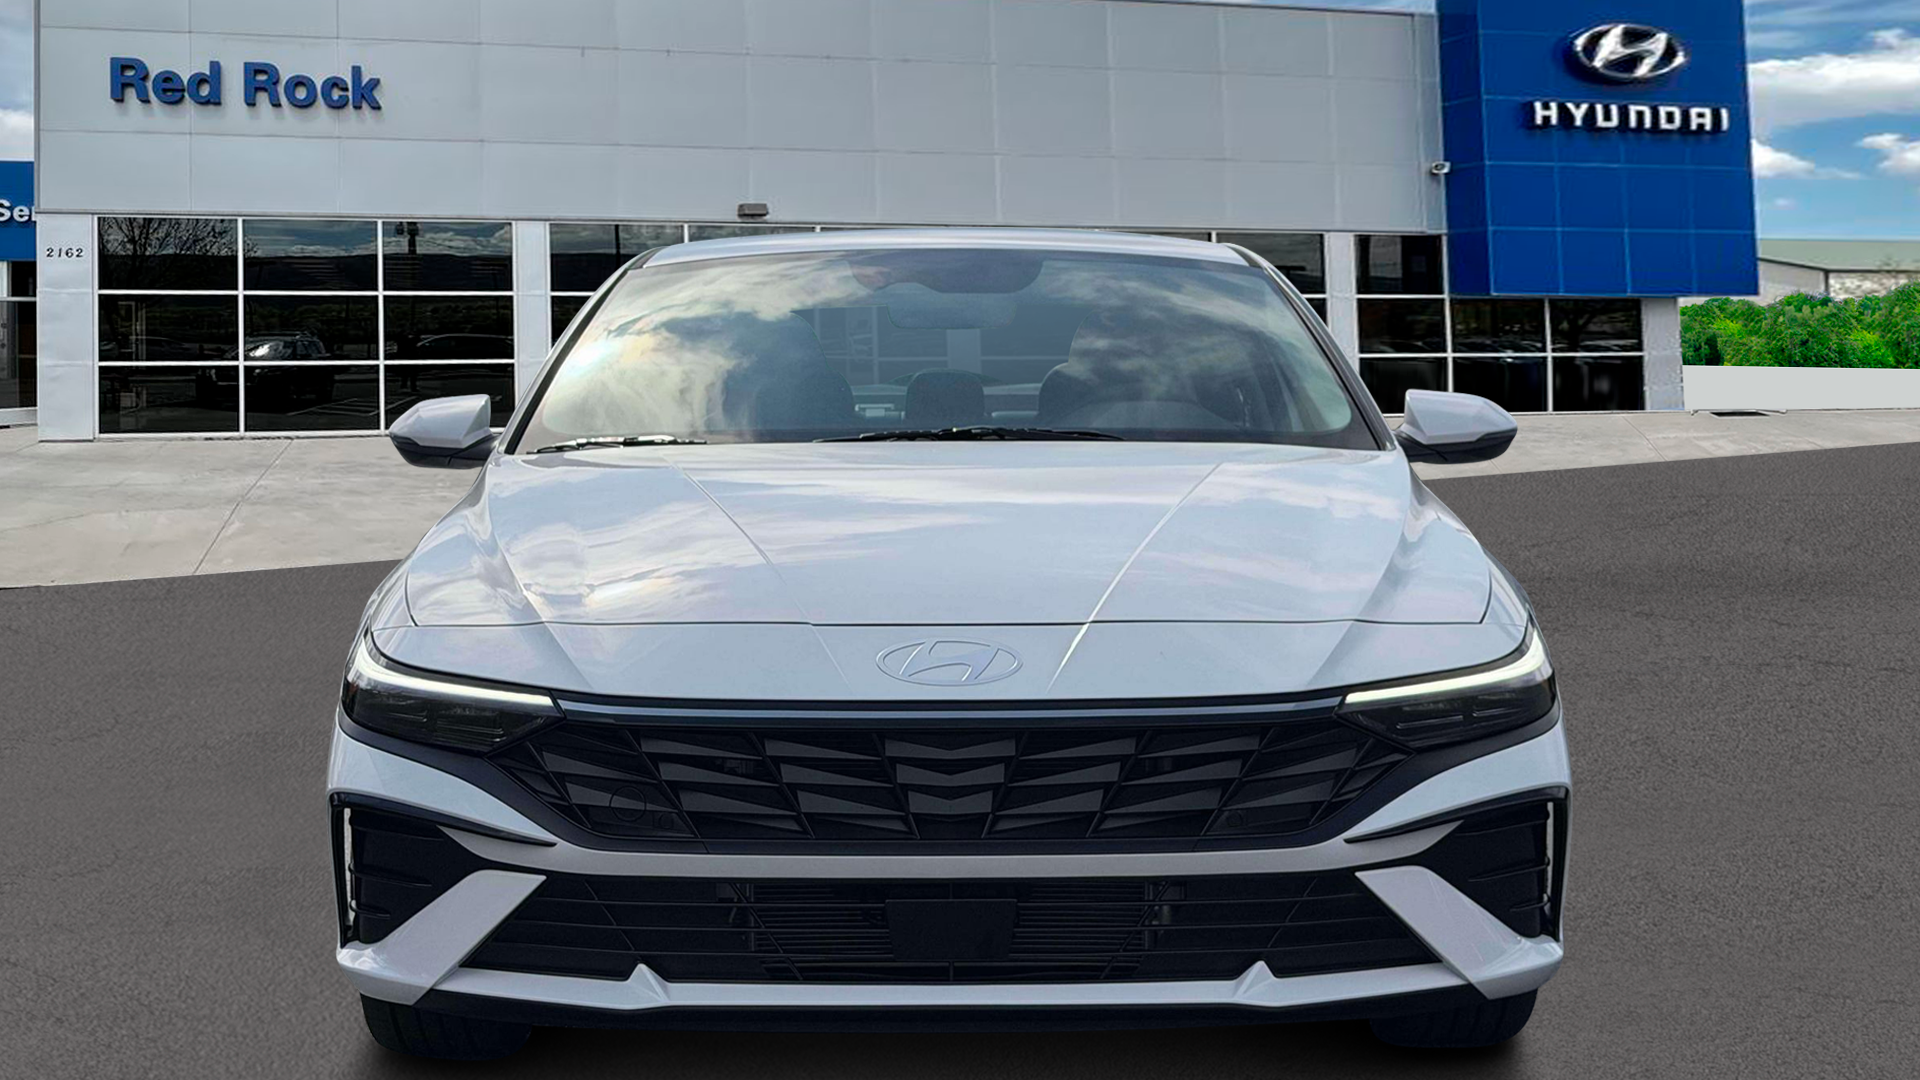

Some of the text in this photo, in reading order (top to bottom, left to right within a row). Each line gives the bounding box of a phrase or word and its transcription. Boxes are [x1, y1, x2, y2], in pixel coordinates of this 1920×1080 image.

[109, 56, 382, 110] Red Rock
[1533, 100, 1730, 132] HYUNDAI
[46, 247, 83, 258] 2162
